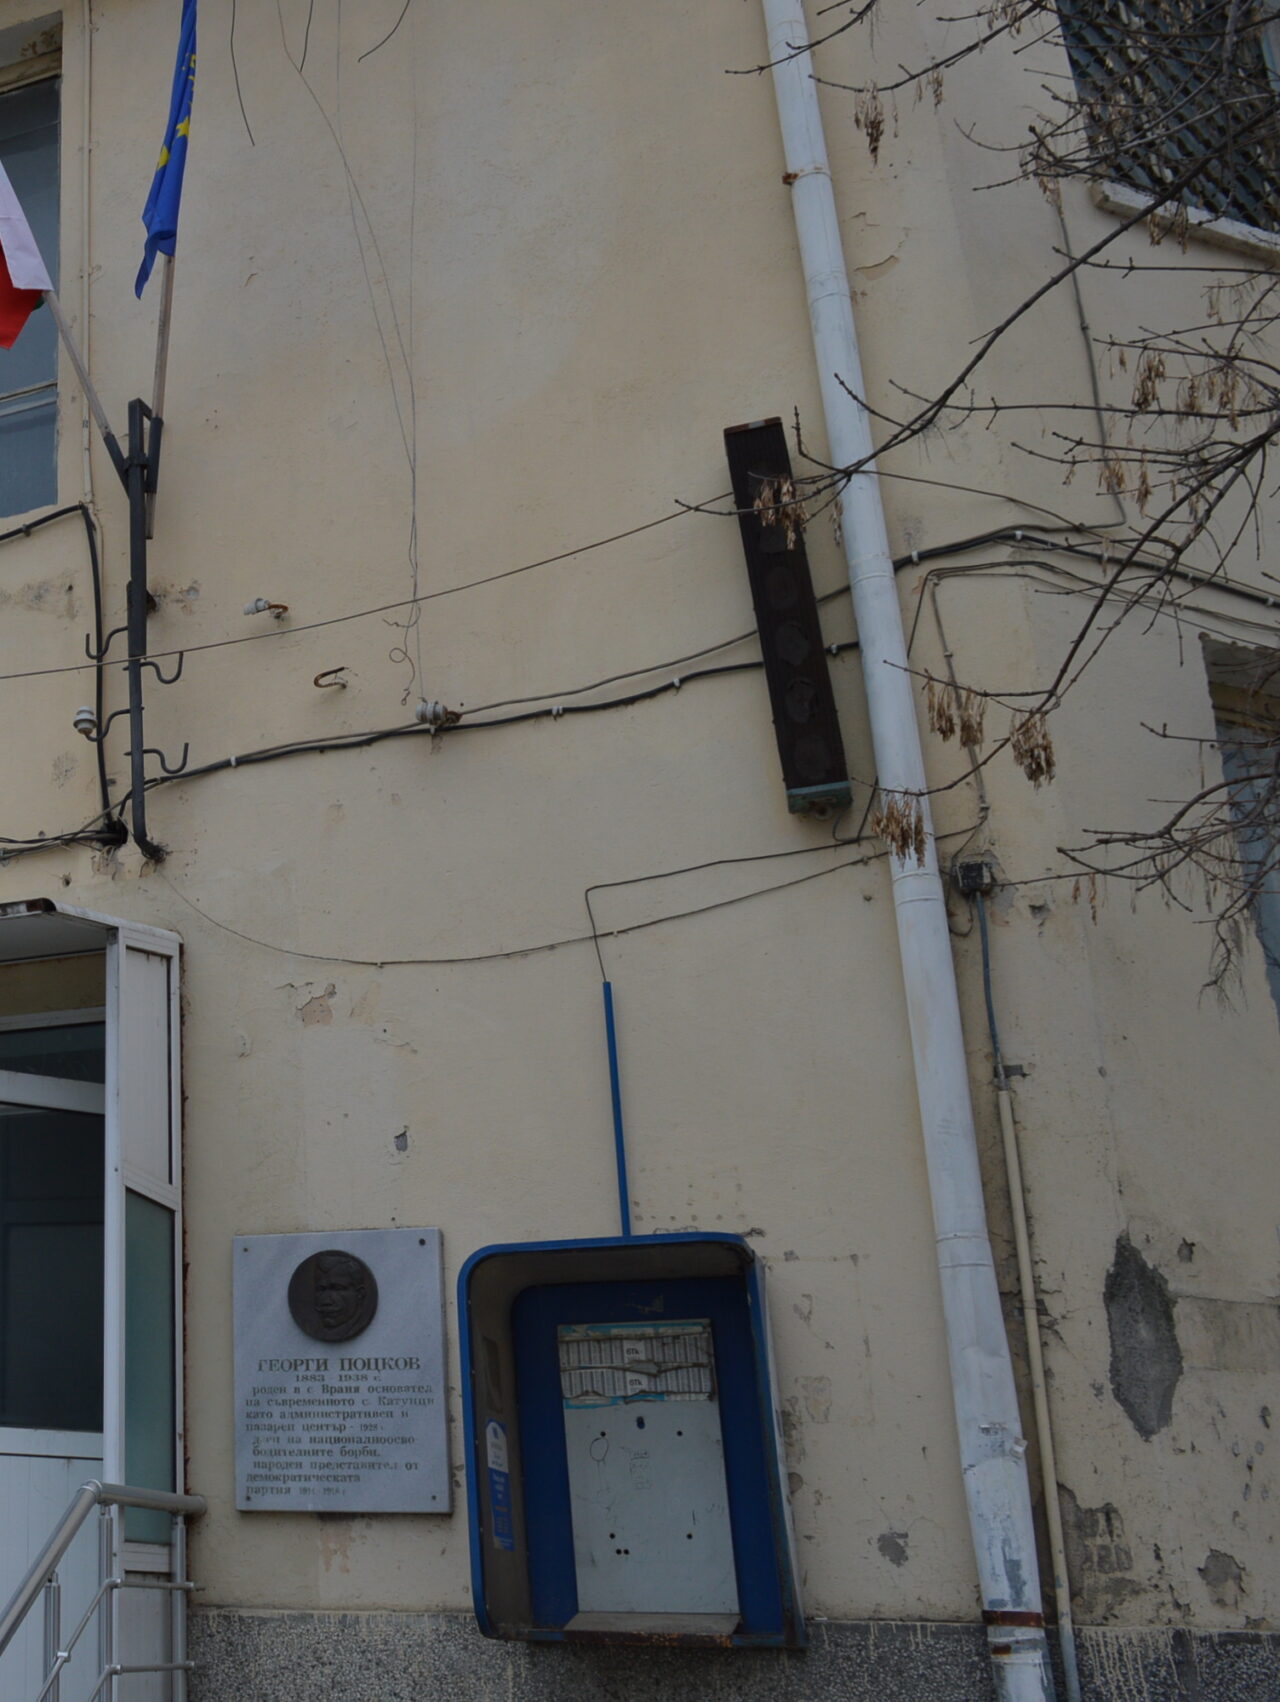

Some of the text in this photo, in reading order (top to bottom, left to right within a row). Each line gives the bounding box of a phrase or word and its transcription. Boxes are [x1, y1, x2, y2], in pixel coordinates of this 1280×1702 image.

[257, 1356, 421, 1374] ГЕОРГИ ПОЦКОВ
[252, 1385, 287, 1397] роден
[321, 1384, 360, 1396] Враня
[367, 1384, 432, 1394] основател
[245, 1398, 260, 1406] на
[378, 1396, 435, 1408] Катунци
[245, 1410, 273, 1419] като
[302, 1422, 346, 1434] център
[253, 1460, 303, 1471] народен
[405, 1462, 418, 1471] от
[246, 1473, 360, 1484] демократическата
